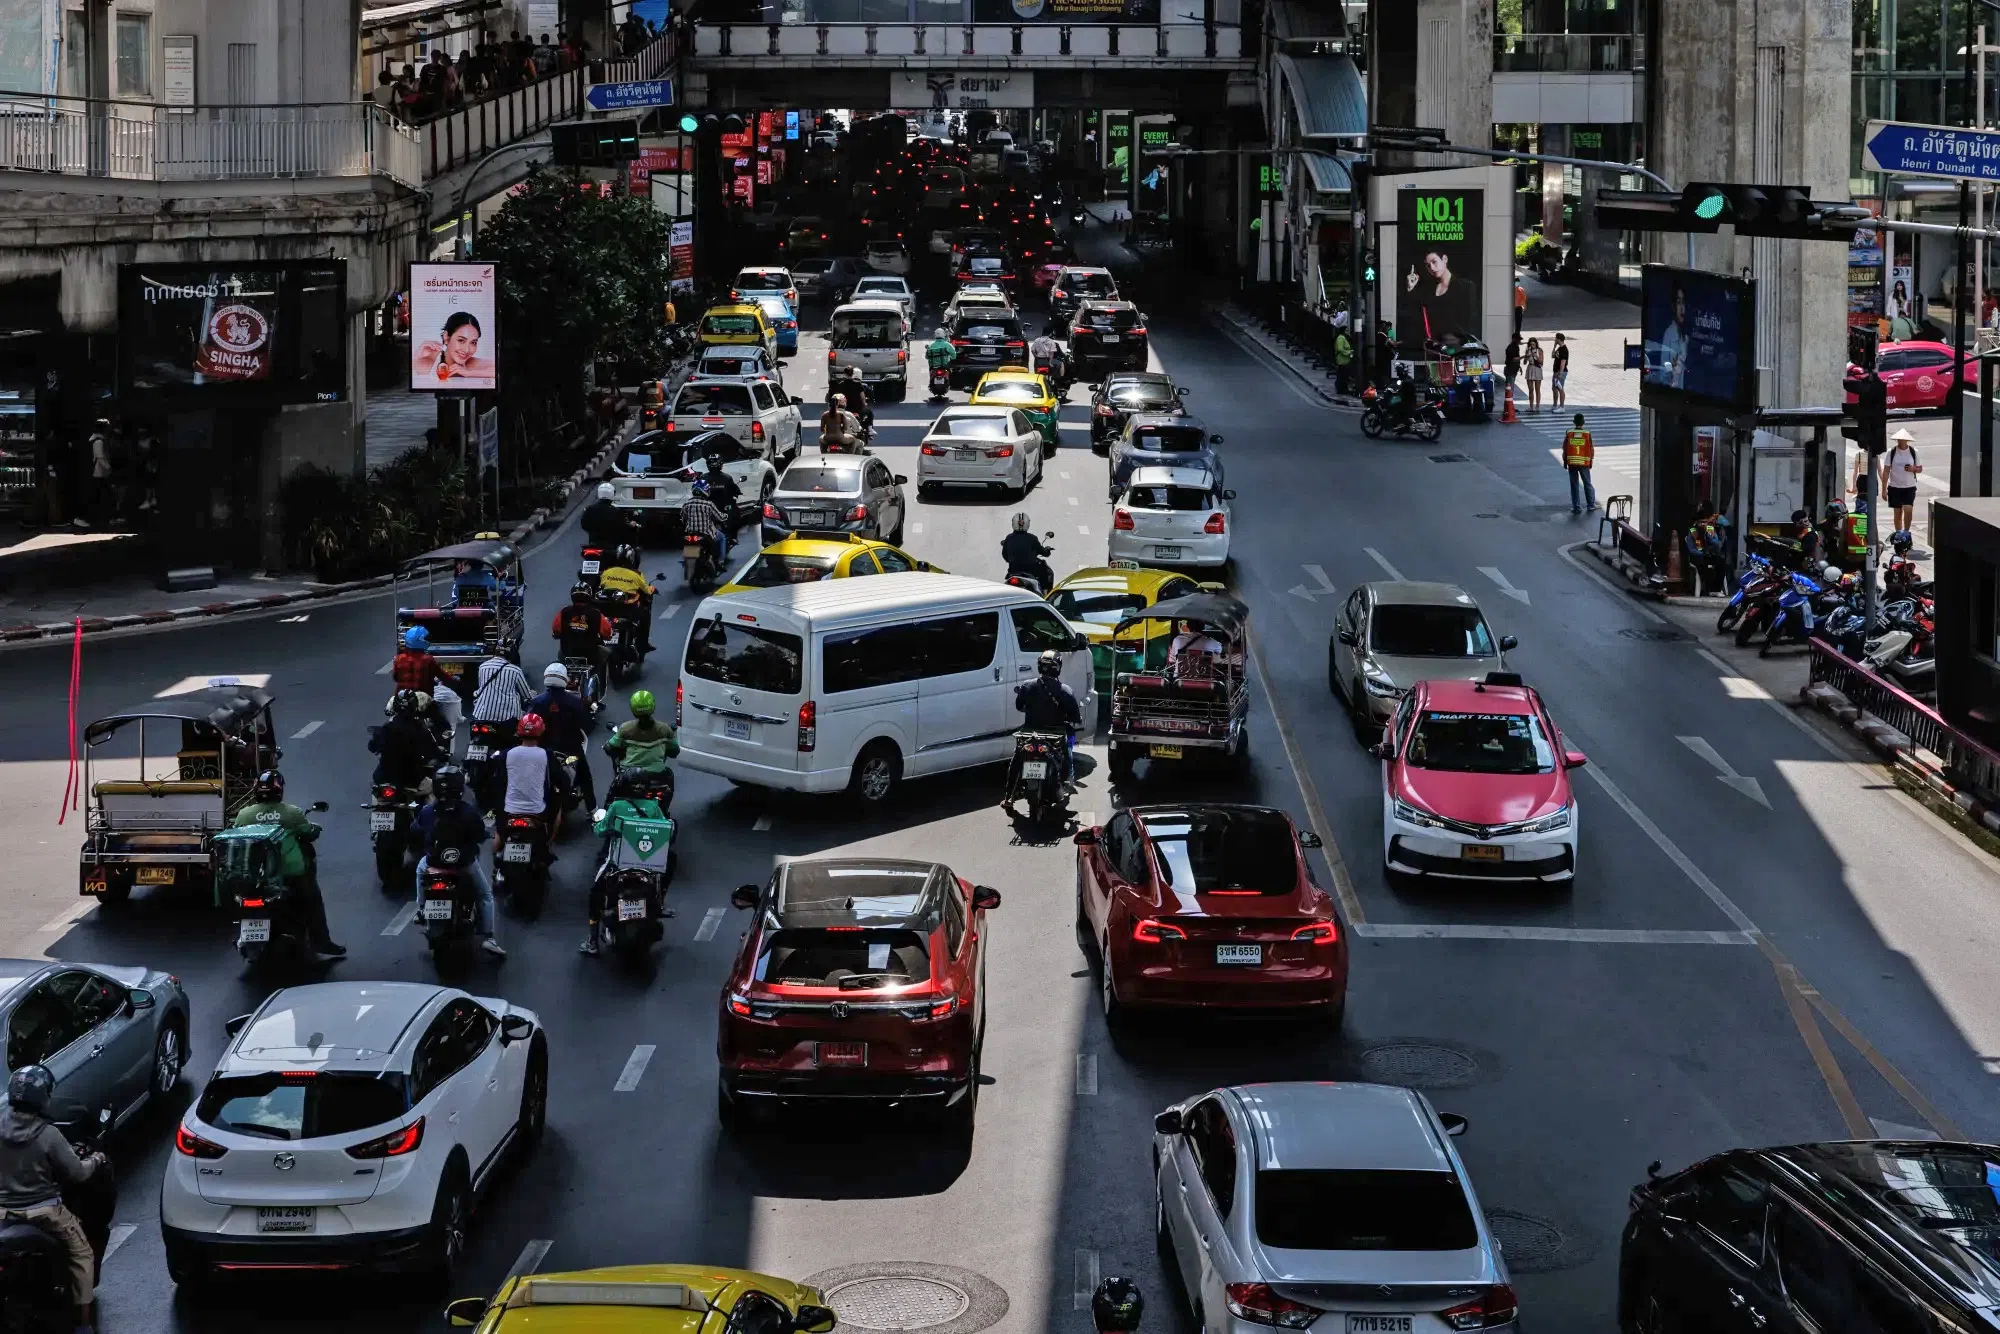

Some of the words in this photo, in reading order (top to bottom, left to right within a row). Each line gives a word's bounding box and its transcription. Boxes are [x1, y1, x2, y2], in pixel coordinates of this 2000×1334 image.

[1903, 137, 1918, 152] ถ.
[1901, 157, 1931, 170] Henri
[1936, 161, 1976, 174] Dunant
[1982, 165, 2000, 176] Rd.
[1416, 197, 1464, 222] NO.1
[1417, 222, 1464, 232] NETWORK
[1416, 232, 1426, 241] IN
[1427, 232, 1464, 241] THAILAND
[210, 350, 260, 369] SINGHA
[214, 365, 231, 374] SODA
[1117, 561, 1130, 569] TAXI
[1430, 713, 1475, 721] SMART
[1141, 720, 1201, 731] THAILAND
[256, 810, 281, 821] Grab
[1238, 946, 1260, 956] 6550
[1379, 1317, 1411, 1332] 5215
